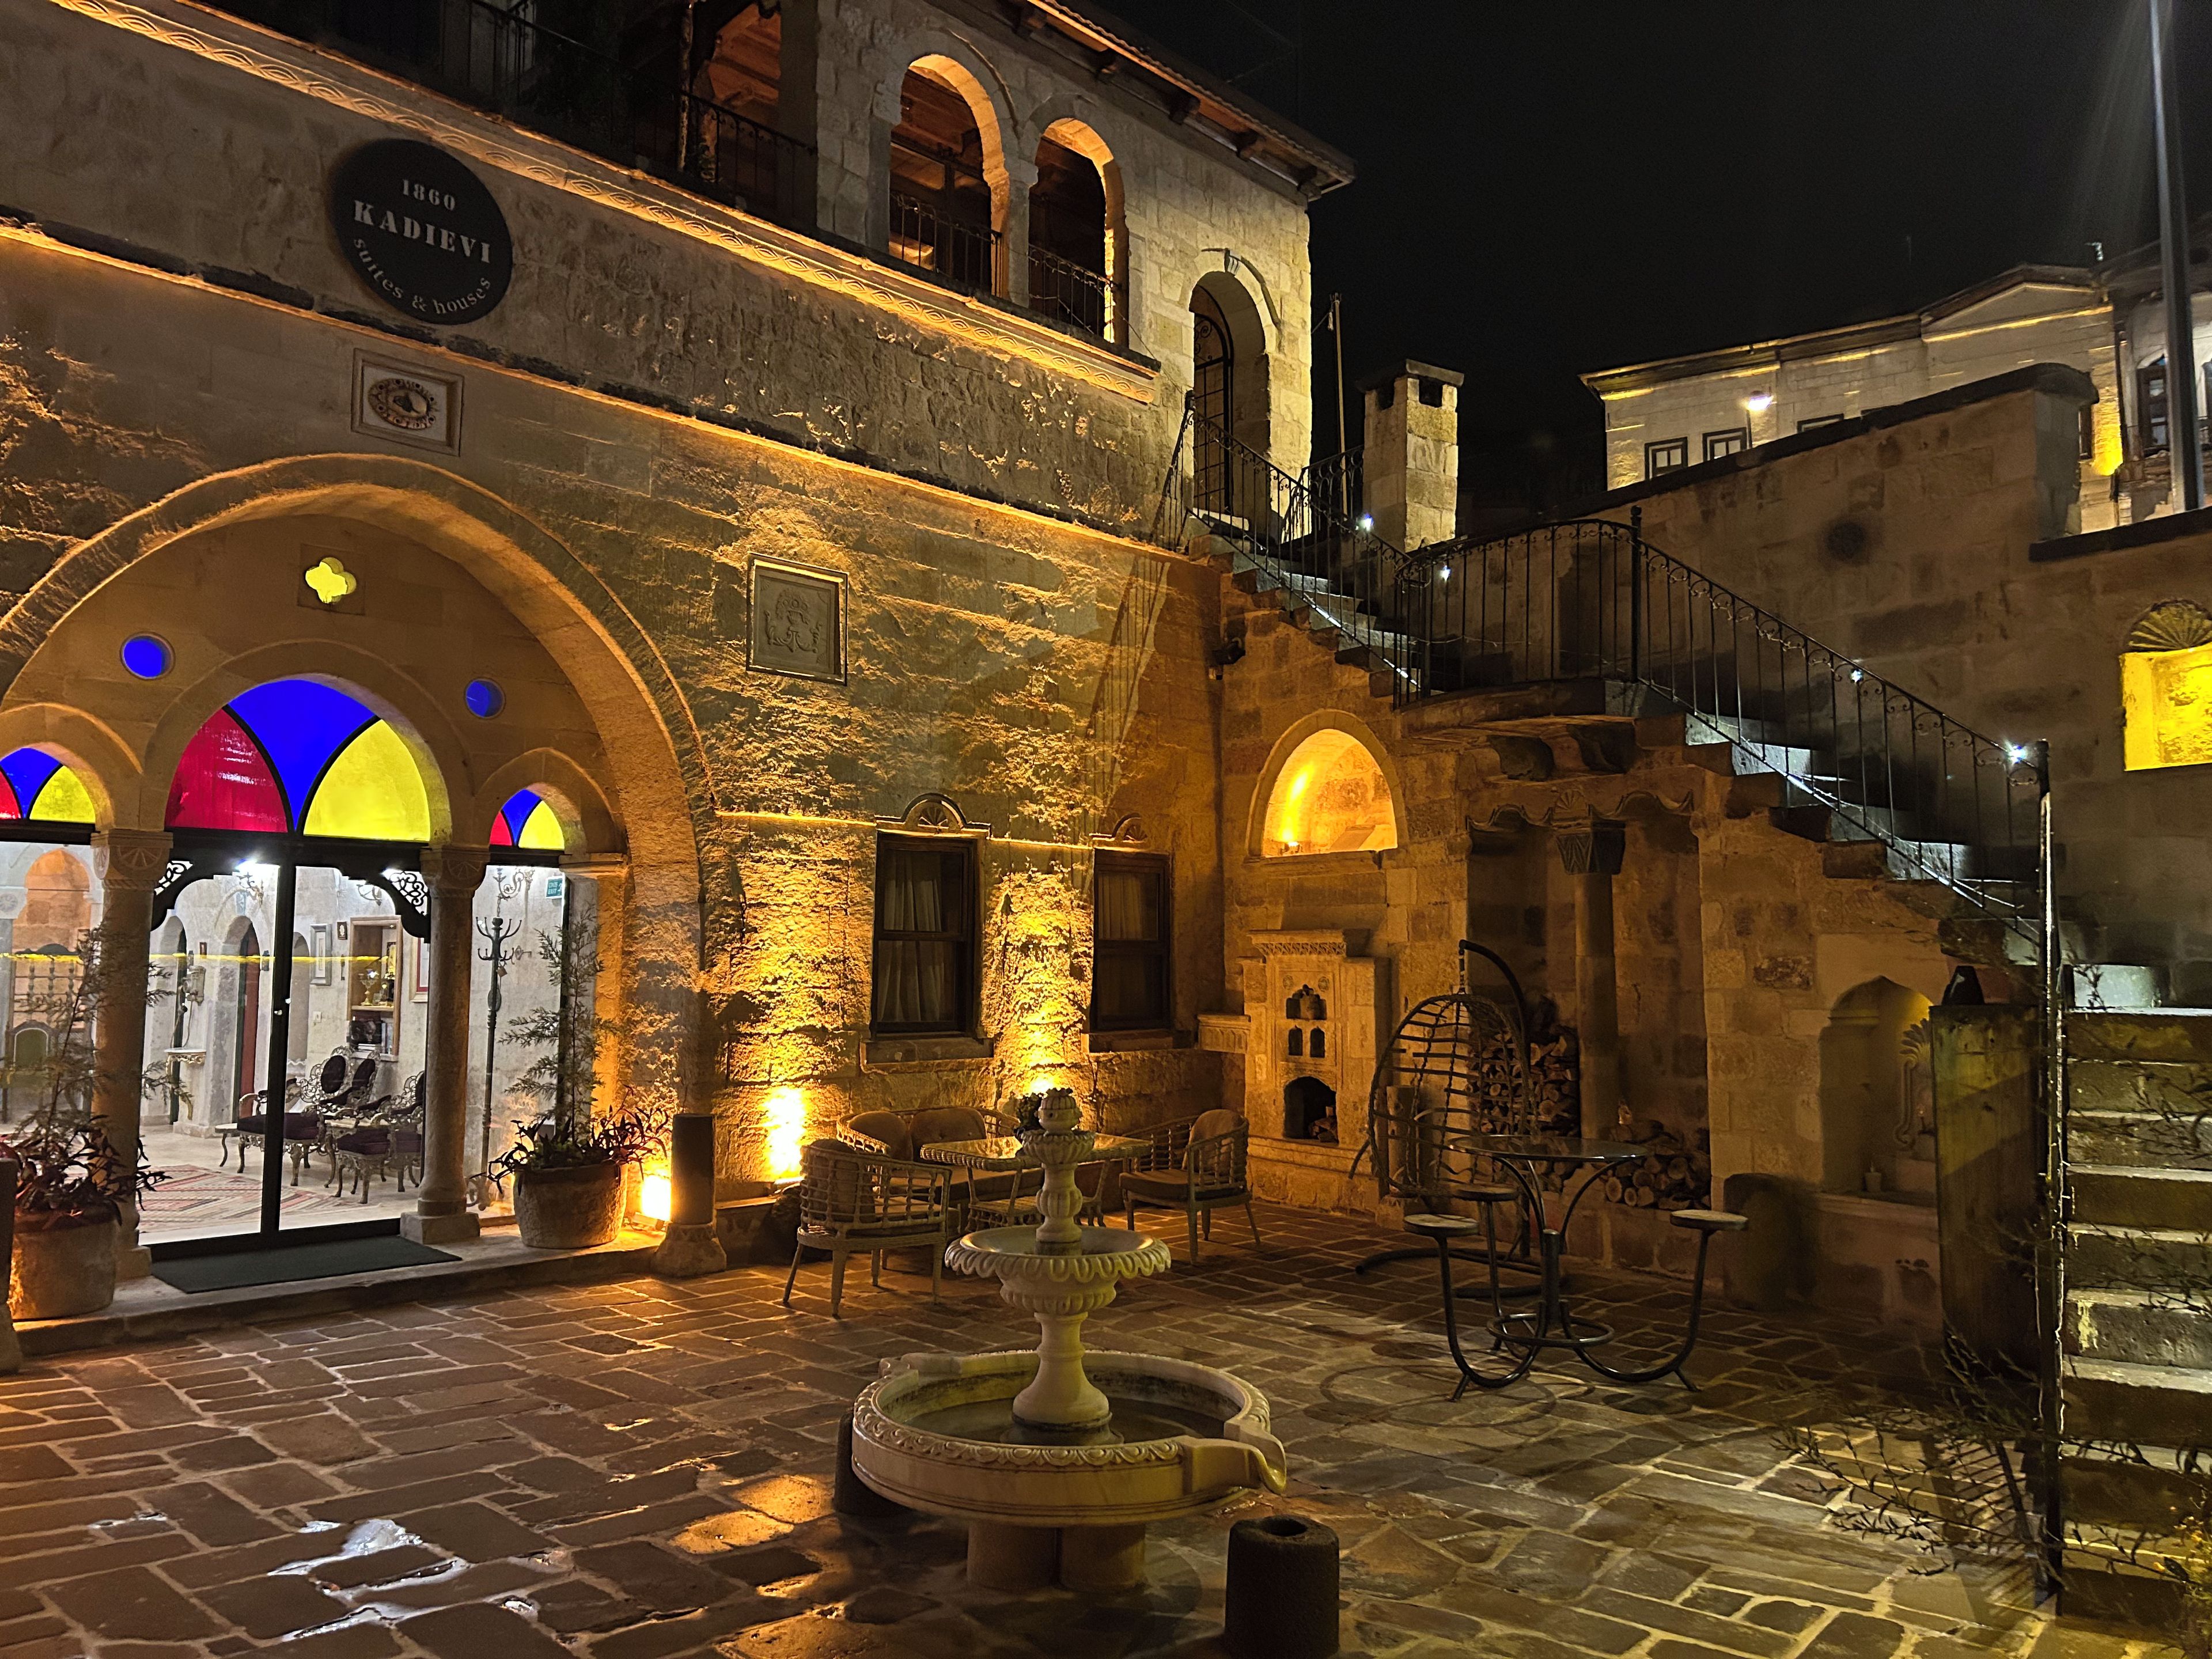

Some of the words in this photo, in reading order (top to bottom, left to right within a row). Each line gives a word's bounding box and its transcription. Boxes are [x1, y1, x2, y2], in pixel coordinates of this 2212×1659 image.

[403, 179, 456, 211] 1860
[354, 200, 490, 263] KADIEVI
[354, 238, 402, 298] suites
[412, 295, 427, 312] &
[433, 278, 490, 315] houses
